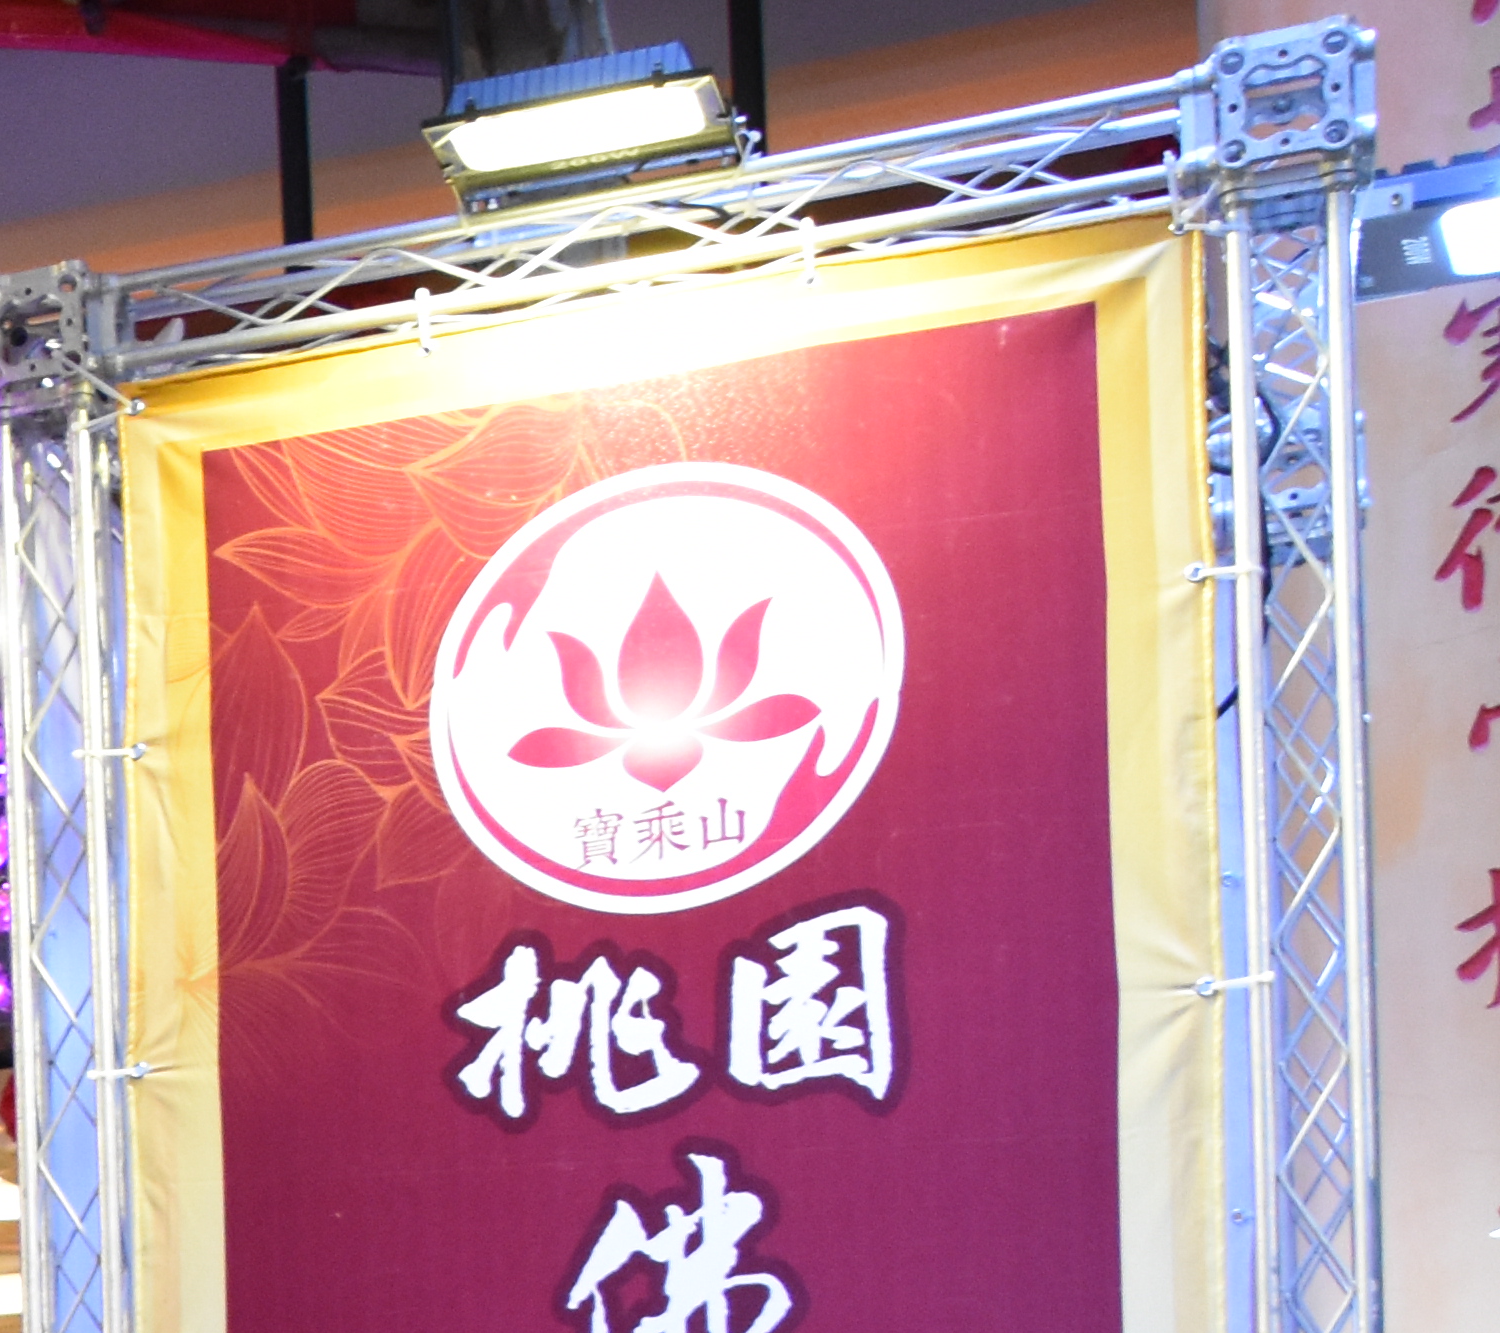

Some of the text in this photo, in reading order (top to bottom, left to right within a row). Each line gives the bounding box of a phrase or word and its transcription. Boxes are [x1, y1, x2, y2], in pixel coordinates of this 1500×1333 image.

[574, 797, 749, 871] 寶乘山
[457, 905, 890, 1118] 桃園
